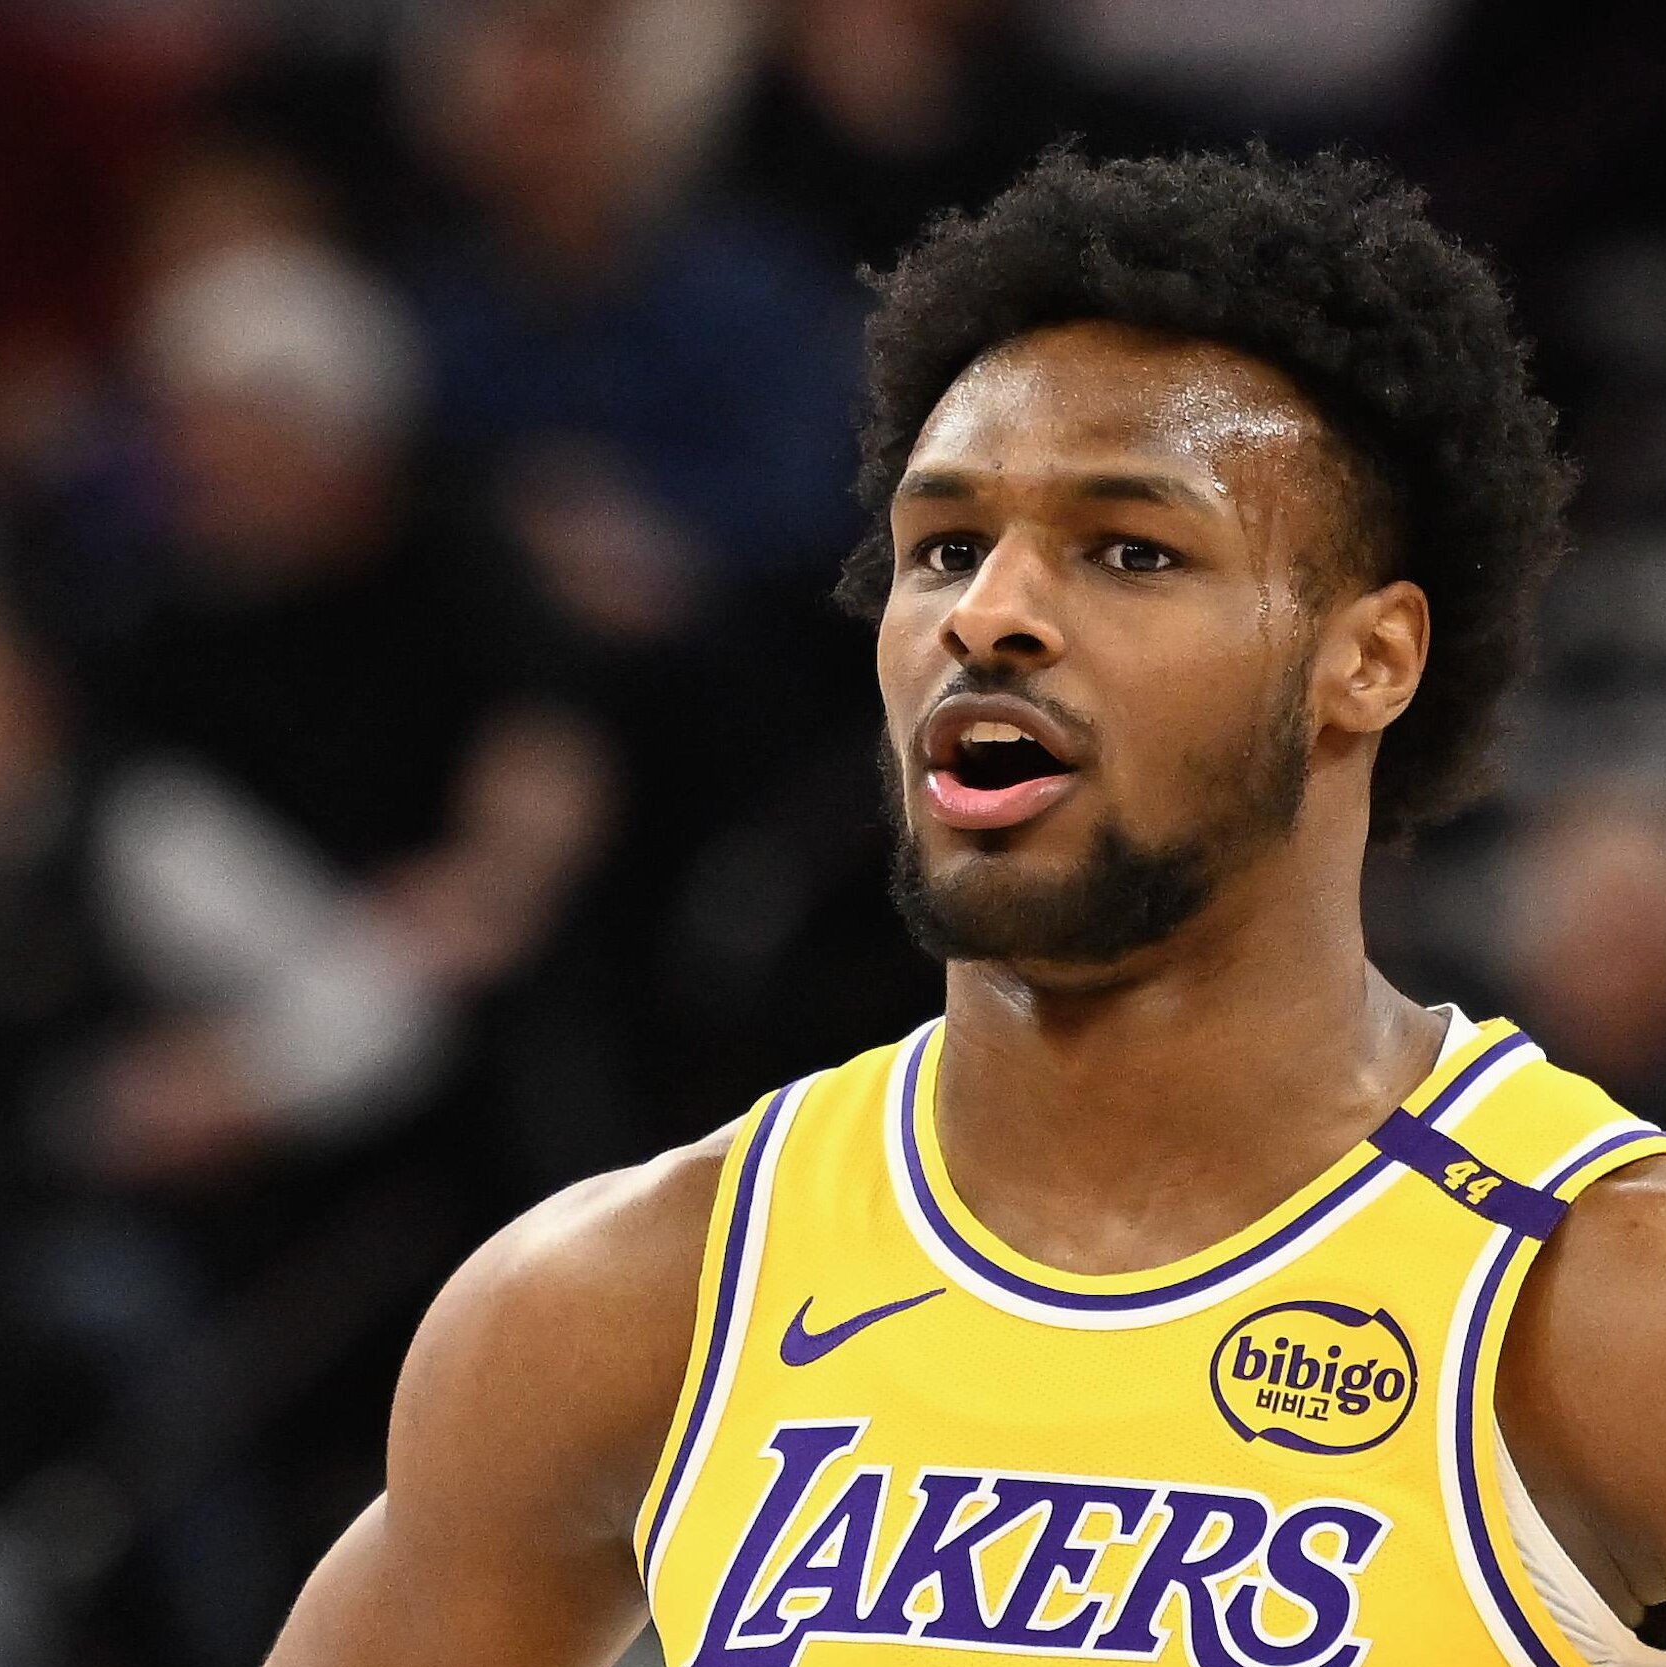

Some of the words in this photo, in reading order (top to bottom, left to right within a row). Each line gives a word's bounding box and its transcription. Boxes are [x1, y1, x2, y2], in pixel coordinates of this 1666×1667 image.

[1444, 1160, 1502, 1205] 44
[1232, 1336, 1405, 1415] bibigo
[1256, 1388, 1329, 1421] 비비고
